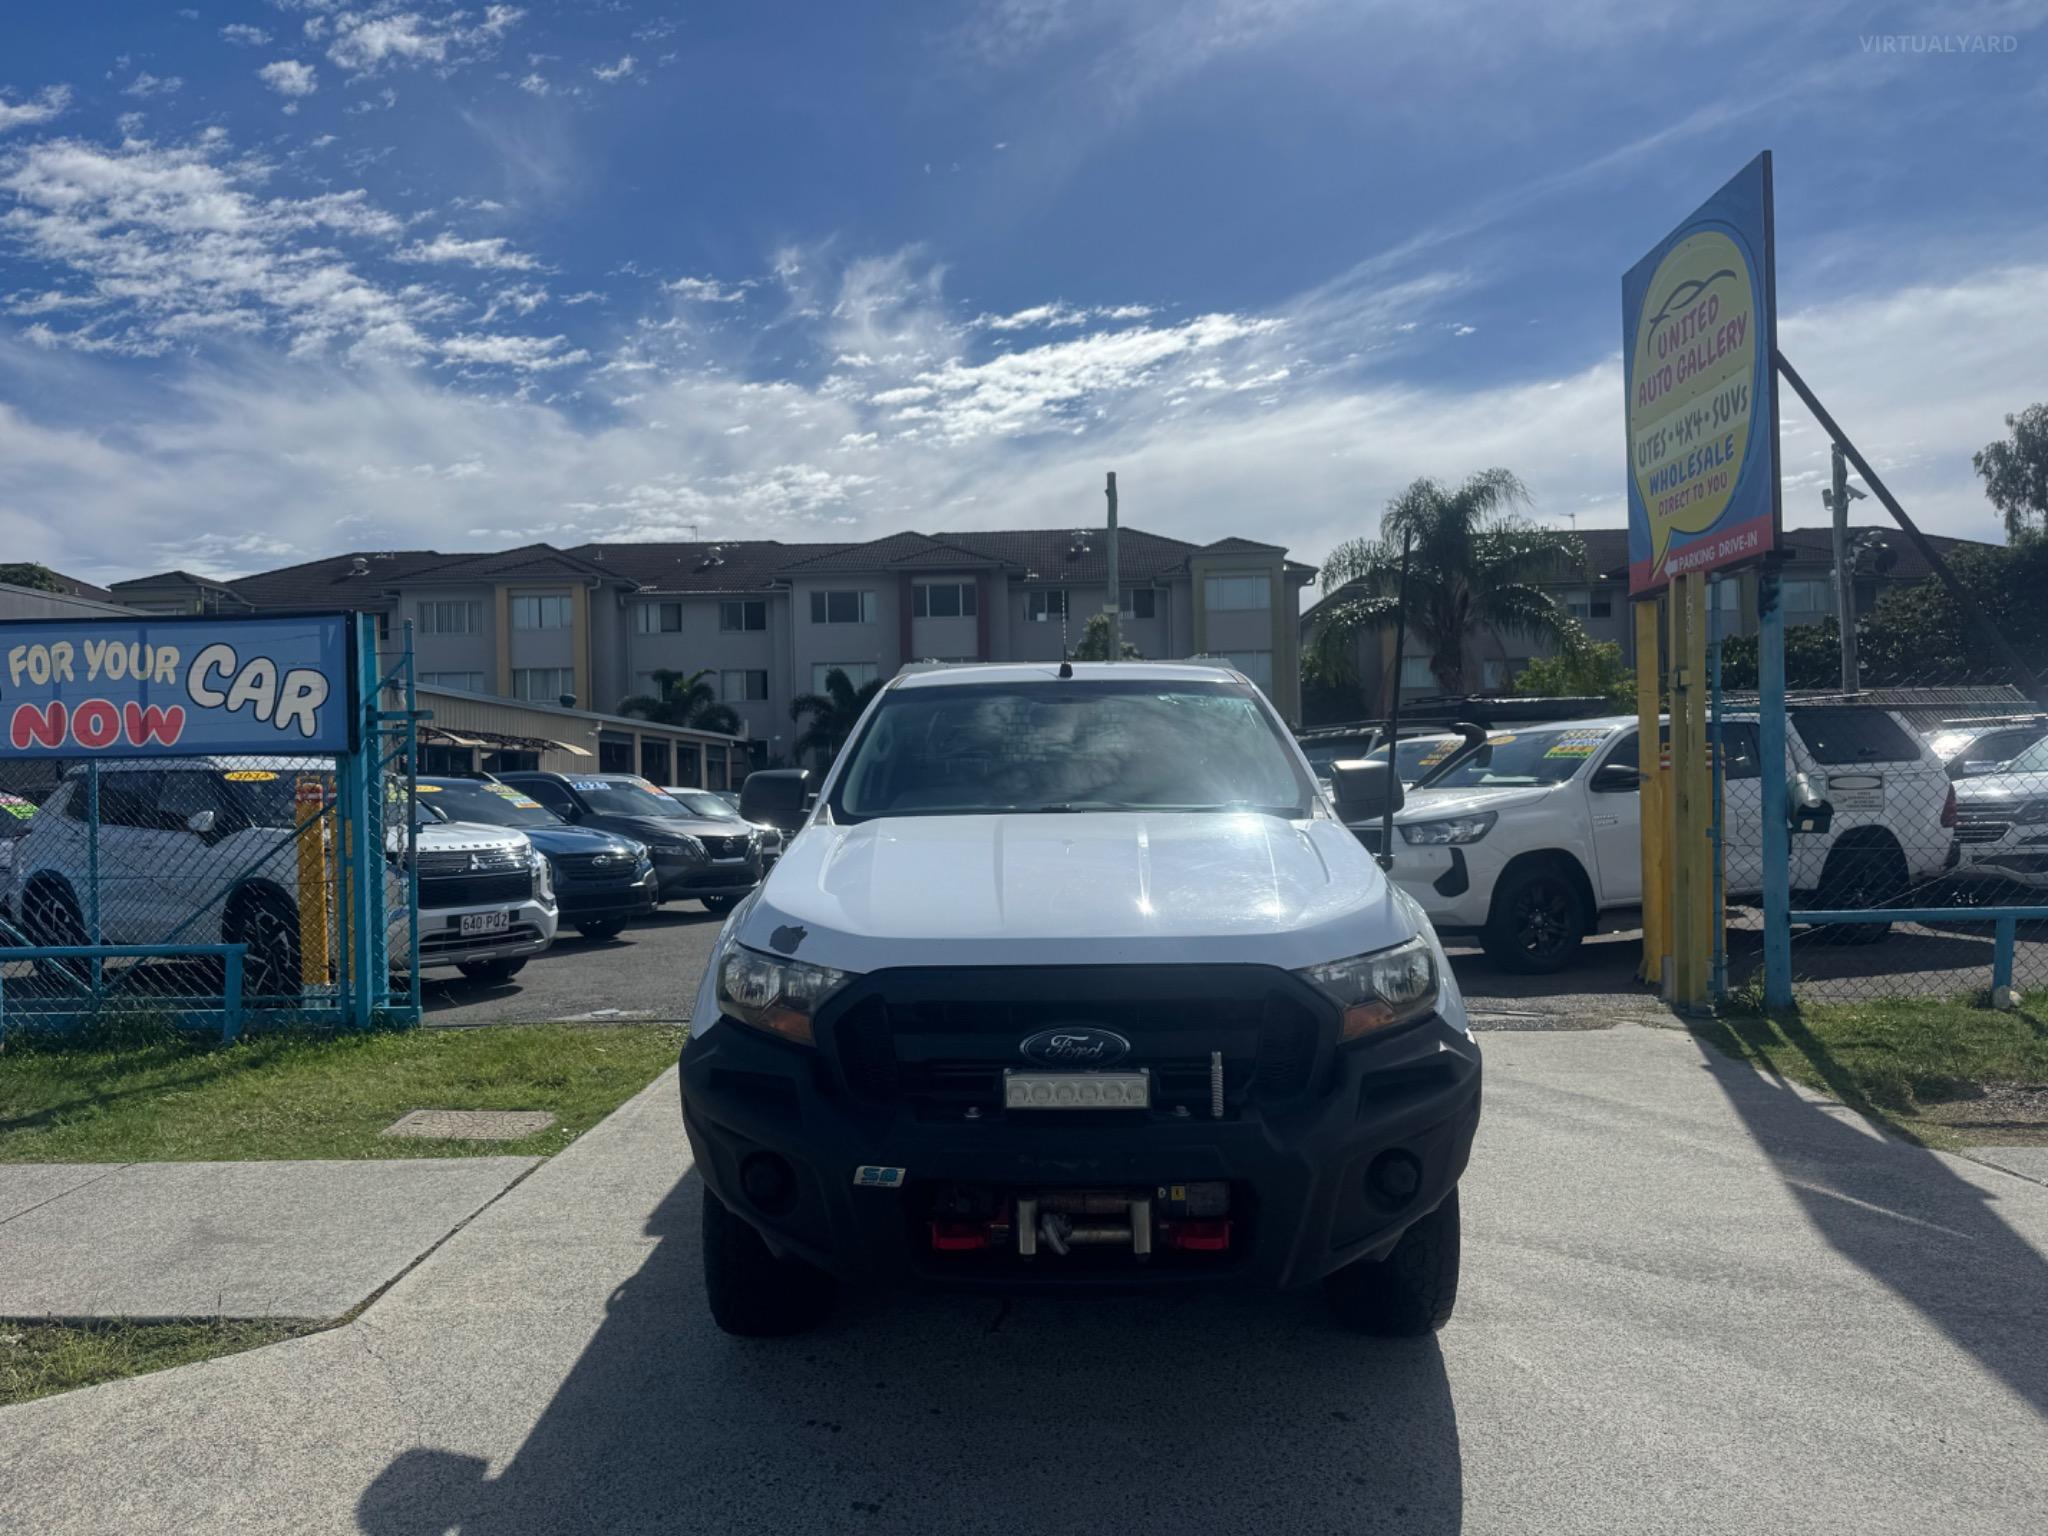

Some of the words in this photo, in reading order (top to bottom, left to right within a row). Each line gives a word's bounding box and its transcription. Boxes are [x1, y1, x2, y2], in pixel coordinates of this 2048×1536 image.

[1657, 293, 1719, 360] UNITED
[1638, 364, 1673, 409] AUTO
[1676, 310, 1748, 385] GALLERY
[1638, 427, 1666, 468] UTES
[1674, 407, 1703, 448] 4X4
[1649, 433, 1735, 497] WHOLESALE
[1658, 487, 1690, 517] DIRECT
[1692, 481, 1704, 502] TO
[1706, 471, 1728, 497] YOU
[1678, 544, 1716, 571] PARKING
[8, 640, 75, 688] FOR
[83, 639, 181, 685] YOUR
[186, 643, 331, 739] CAR
[10, 698, 186, 750] NOW
[1046, 1034, 1104, 1059] Ford
